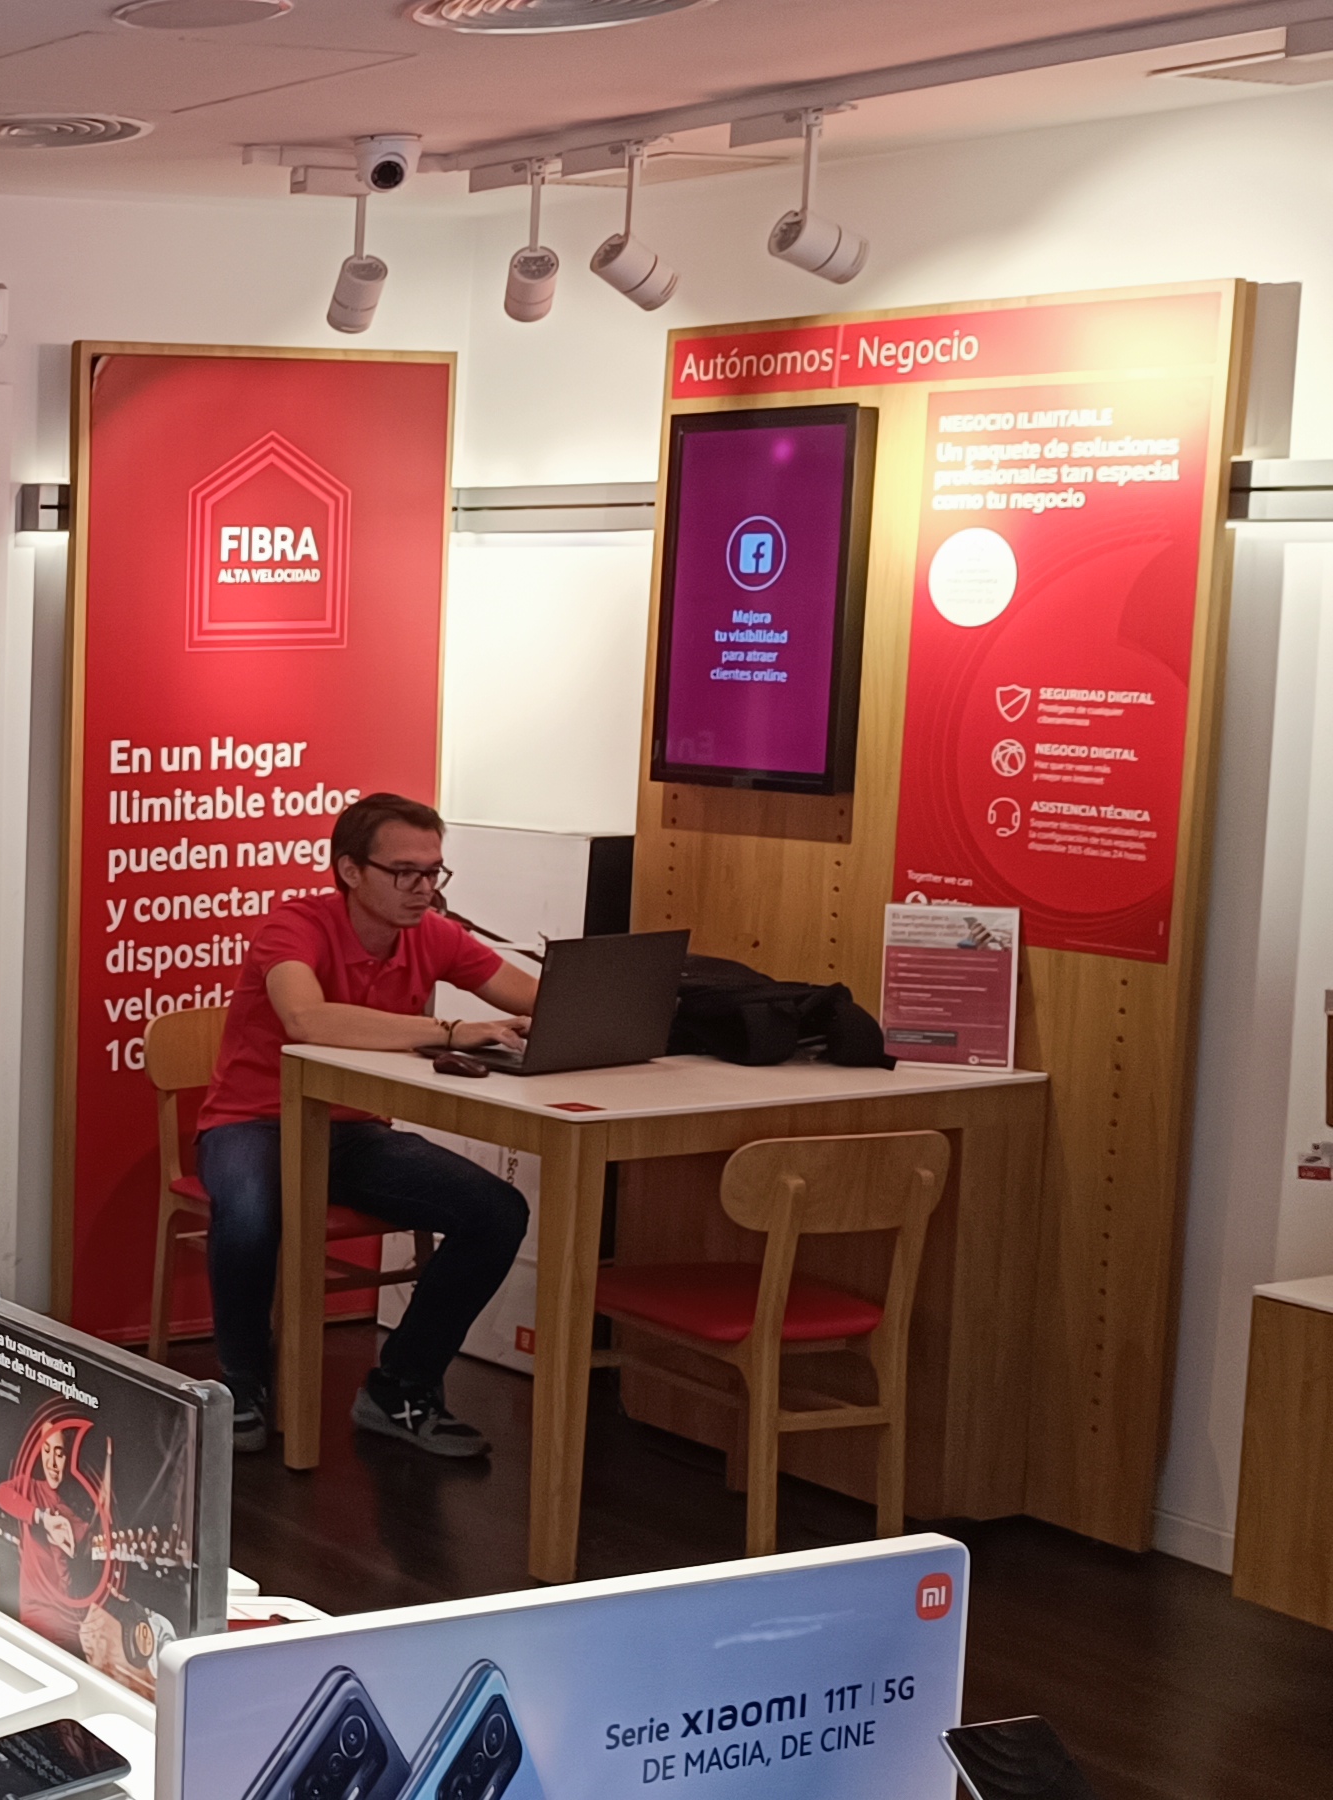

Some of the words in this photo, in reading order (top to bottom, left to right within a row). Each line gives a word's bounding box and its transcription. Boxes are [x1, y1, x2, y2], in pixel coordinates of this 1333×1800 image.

[679, 348, 834, 383] Autónomos
[857, 330, 979, 374] Negocio
[938, 412, 1015, 433] NEGOCIO
[1016, 407, 1113, 430] ILIMITABLE
[935, 442, 964, 463] Un
[965, 440, 1041, 466] paquete
[1043, 438, 1069, 459] de
[1070, 436, 1181, 458] soluciones
[933, 464, 1058, 491] profesionales
[1060, 464, 1093, 484] tan
[1096, 459, 1180, 487] especial
[932, 493, 984, 511] como
[985, 490, 1008, 510] tu
[1009, 487, 1086, 515] negocio
[220, 526, 319, 562] FIBRA
[217, 568, 251, 583] ALTA
[251, 568, 321, 583] VELOCIDAD
[732, 609, 772, 626] Mejora
[714, 629, 727, 642] tu
[728, 629, 788, 643] visibilidad
[721, 650, 745, 664] para
[745, 649, 778, 663] atraer
[710, 667, 752, 681] clientes
[753, 668, 788, 683] online
[1039, 687, 1106, 703] SEGURIDAD
[1107, 690, 1155, 705] DIGITAL
[109, 739, 152, 774] En
[160, 745, 202, 773] un
[210, 736, 307, 777] Hogar
[1035, 743, 1089, 758] NEGOCIO
[1090, 746, 1139, 762] DIGITAL
[109, 784, 265, 825] Ilimitable
[271, 782, 361, 817] todos
[1030, 801, 1099, 818] ASISTENCIA
[1098, 804, 1151, 822] TÉCNICA
[107, 837, 228, 883] pueden
[236, 838, 332, 872] naveg
[106, 898, 127, 932] y
[133, 886, 276, 923] conectar
[105, 1037, 146, 1072] 1G
[4, 1334, 17, 1352] tu
[16, 1342, 76, 1379] smartwatch
[11, 1357, 25, 1375] de
[24, 1363, 37, 1381] tu
[36, 1373, 100, 1409] smartphone
[605, 1717, 670, 1750] Serie
[824, 1684, 863, 1714] 11T
[883, 1675, 915, 1705] 5G
[642, 1755, 676, 1784] DE
[684, 1740, 773, 1778] MAGIA,
[780, 1731, 813, 1760] DE
[820, 1720, 876, 1753] CINE
